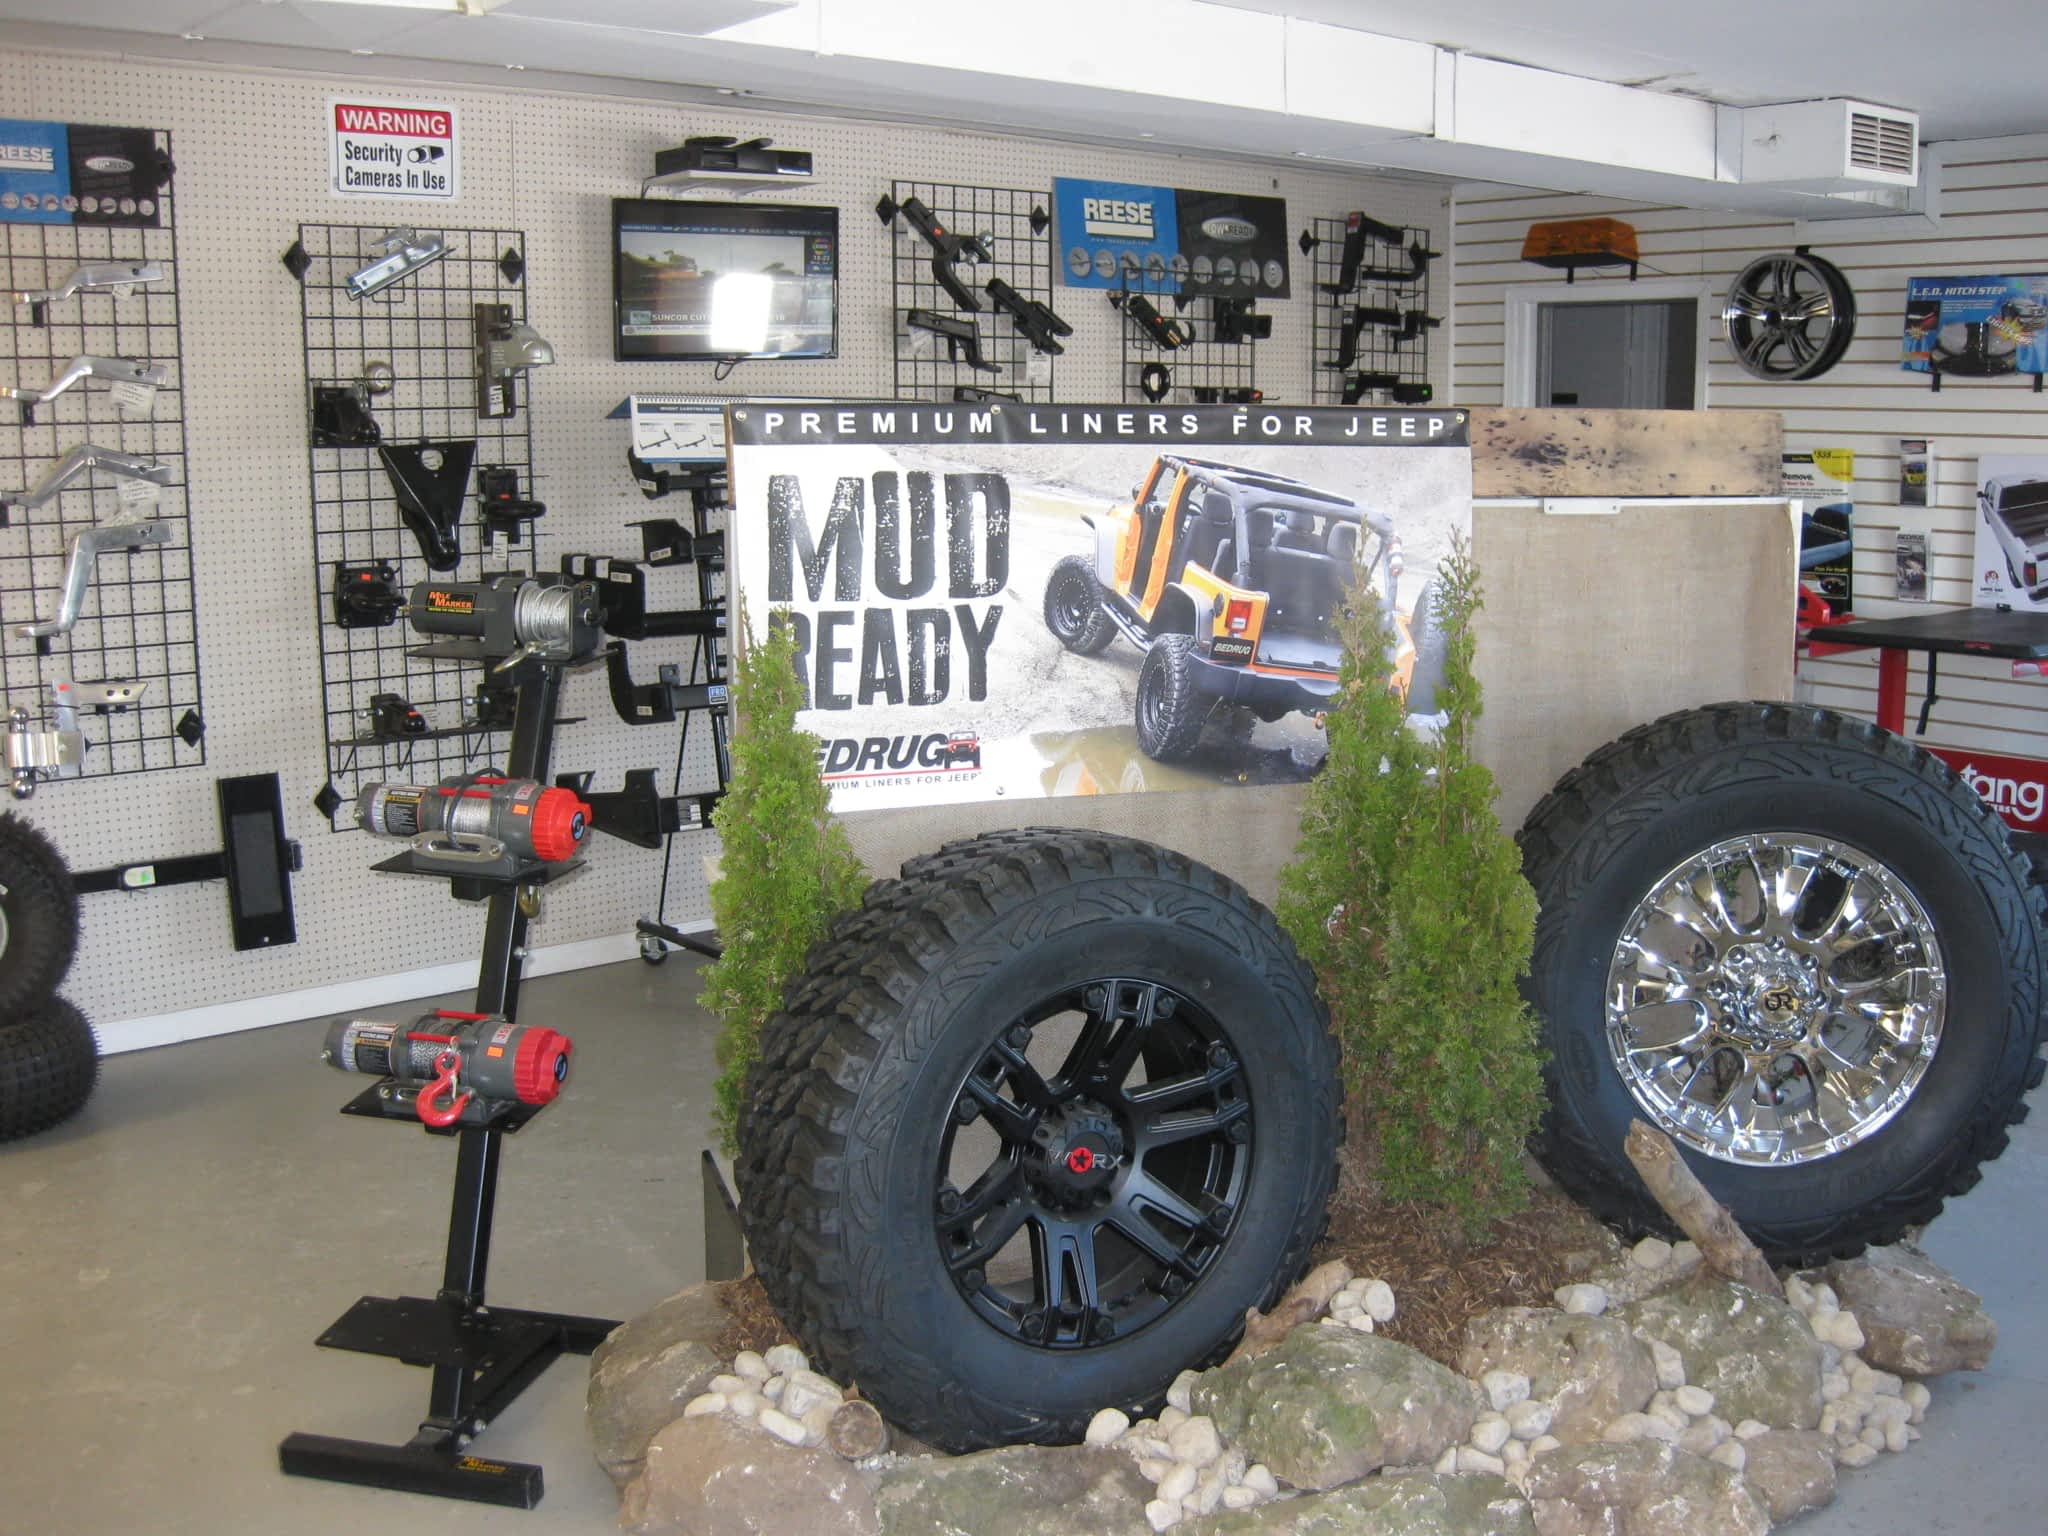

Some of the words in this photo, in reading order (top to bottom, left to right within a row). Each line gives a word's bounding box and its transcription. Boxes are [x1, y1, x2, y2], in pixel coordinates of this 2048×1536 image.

[342, 108, 447, 135] WARNING
[345, 140, 403, 166] Security
[345, 166, 402, 188] Cameras
[407, 169, 418, 188] In
[423, 170, 446, 190] Use
[1083, 198, 1153, 224] REESE
[1912, 287, 1942, 296] L.E.D.
[1944, 287, 1977, 296] HITCH
[1977, 286, 2007, 295] STEP
[652, 313, 688, 321] SUNCOR
[764, 412, 992, 434] PREMIUM
[1030, 412, 1199, 435] LINERS
[1233, 414, 1313, 436] FOR
[1345, 416, 1445, 438] JEEP
[768, 471, 1011, 602] MUD
[1214, 642, 1251, 655] BEDRUG
[865, 776, 912, 788] LINERS
[917, 775, 942, 785] FOR
[947, 772, 979, 783] JEEP
